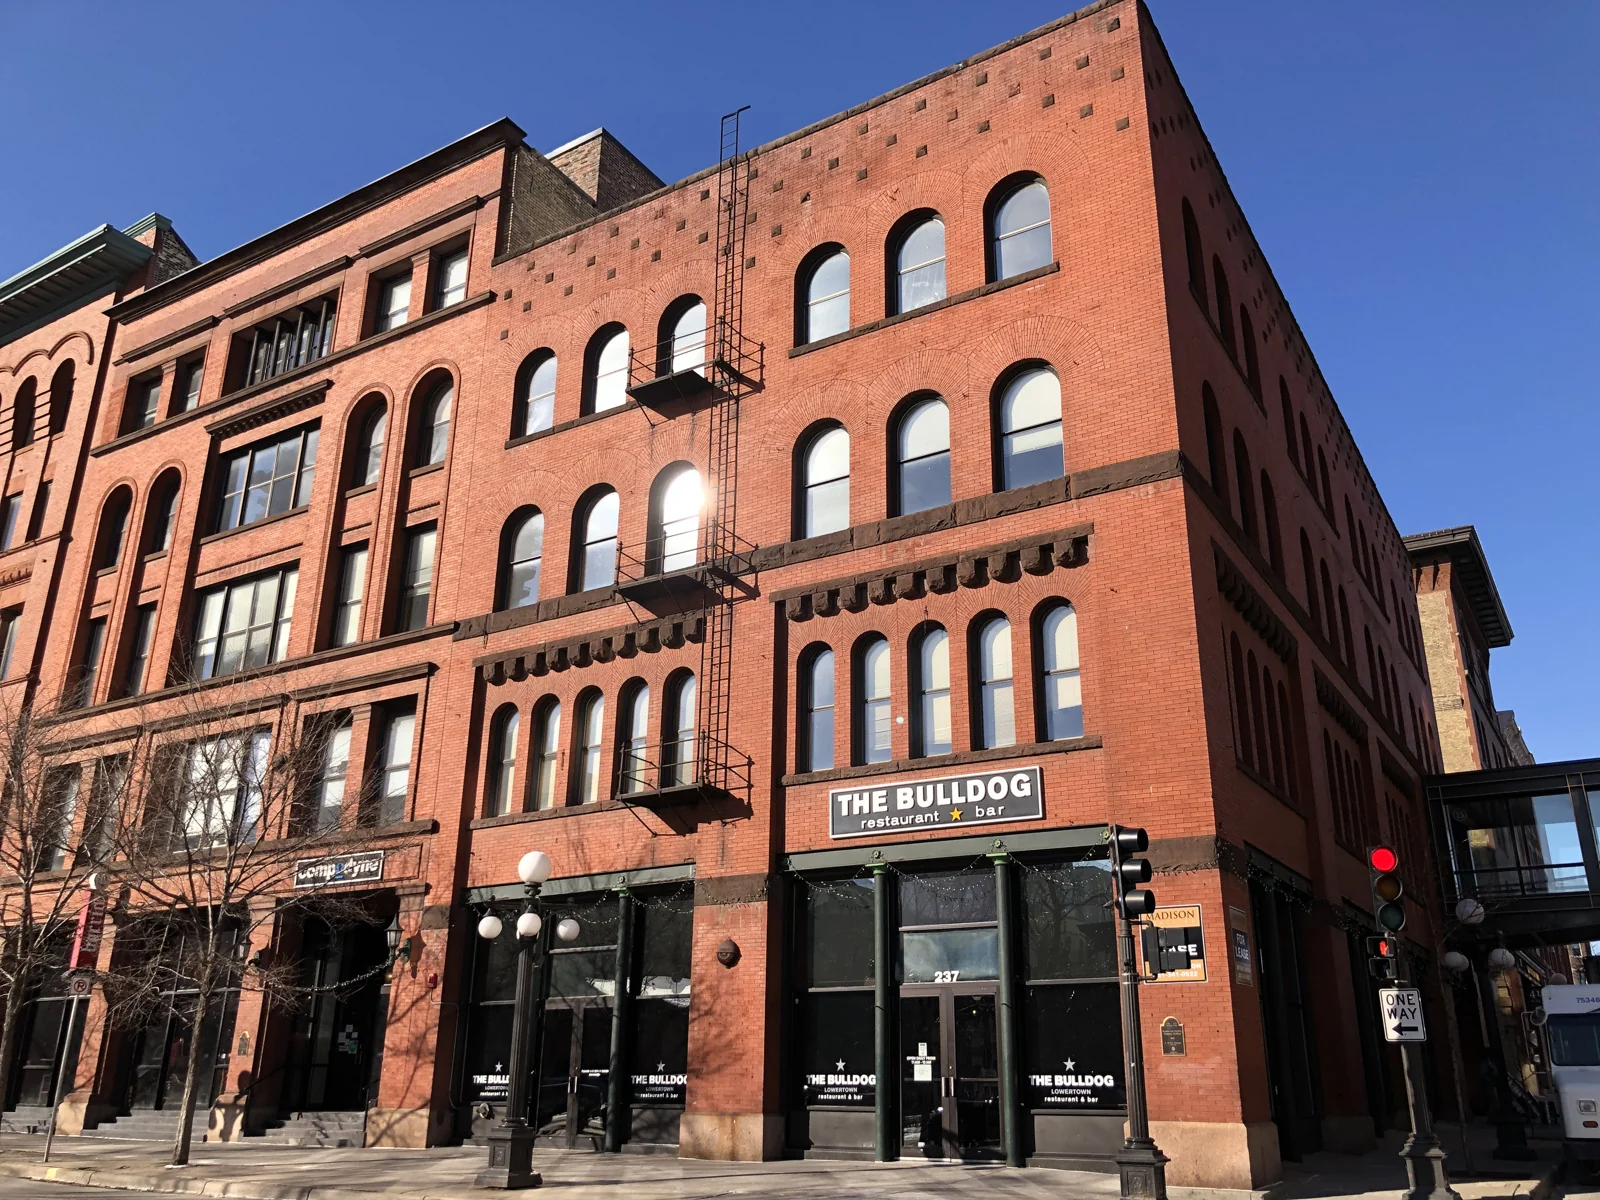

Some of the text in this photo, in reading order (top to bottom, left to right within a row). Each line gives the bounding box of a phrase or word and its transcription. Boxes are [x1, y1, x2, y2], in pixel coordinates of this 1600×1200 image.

[838, 773, 1033, 817] THE BULLDOG
[861, 805, 1005, 829] restaurant bar
[1145, 910, 1195, 921] MADISON
[1236, 933, 1246, 946] FOR
[1234, 946, 1249, 960] LEASE
[934, 970, 960, 983] 237
[1386, 993, 1416, 1006] ONE
[1387, 1007, 1417, 1020] WAY
[472, 1074, 510, 1084] THE BULL
[630, 1075, 648, 1085] THE
[806, 1074, 876, 1085] THE BULLDOG
[1028, 1074, 1115, 1087] THE BULLDOG
